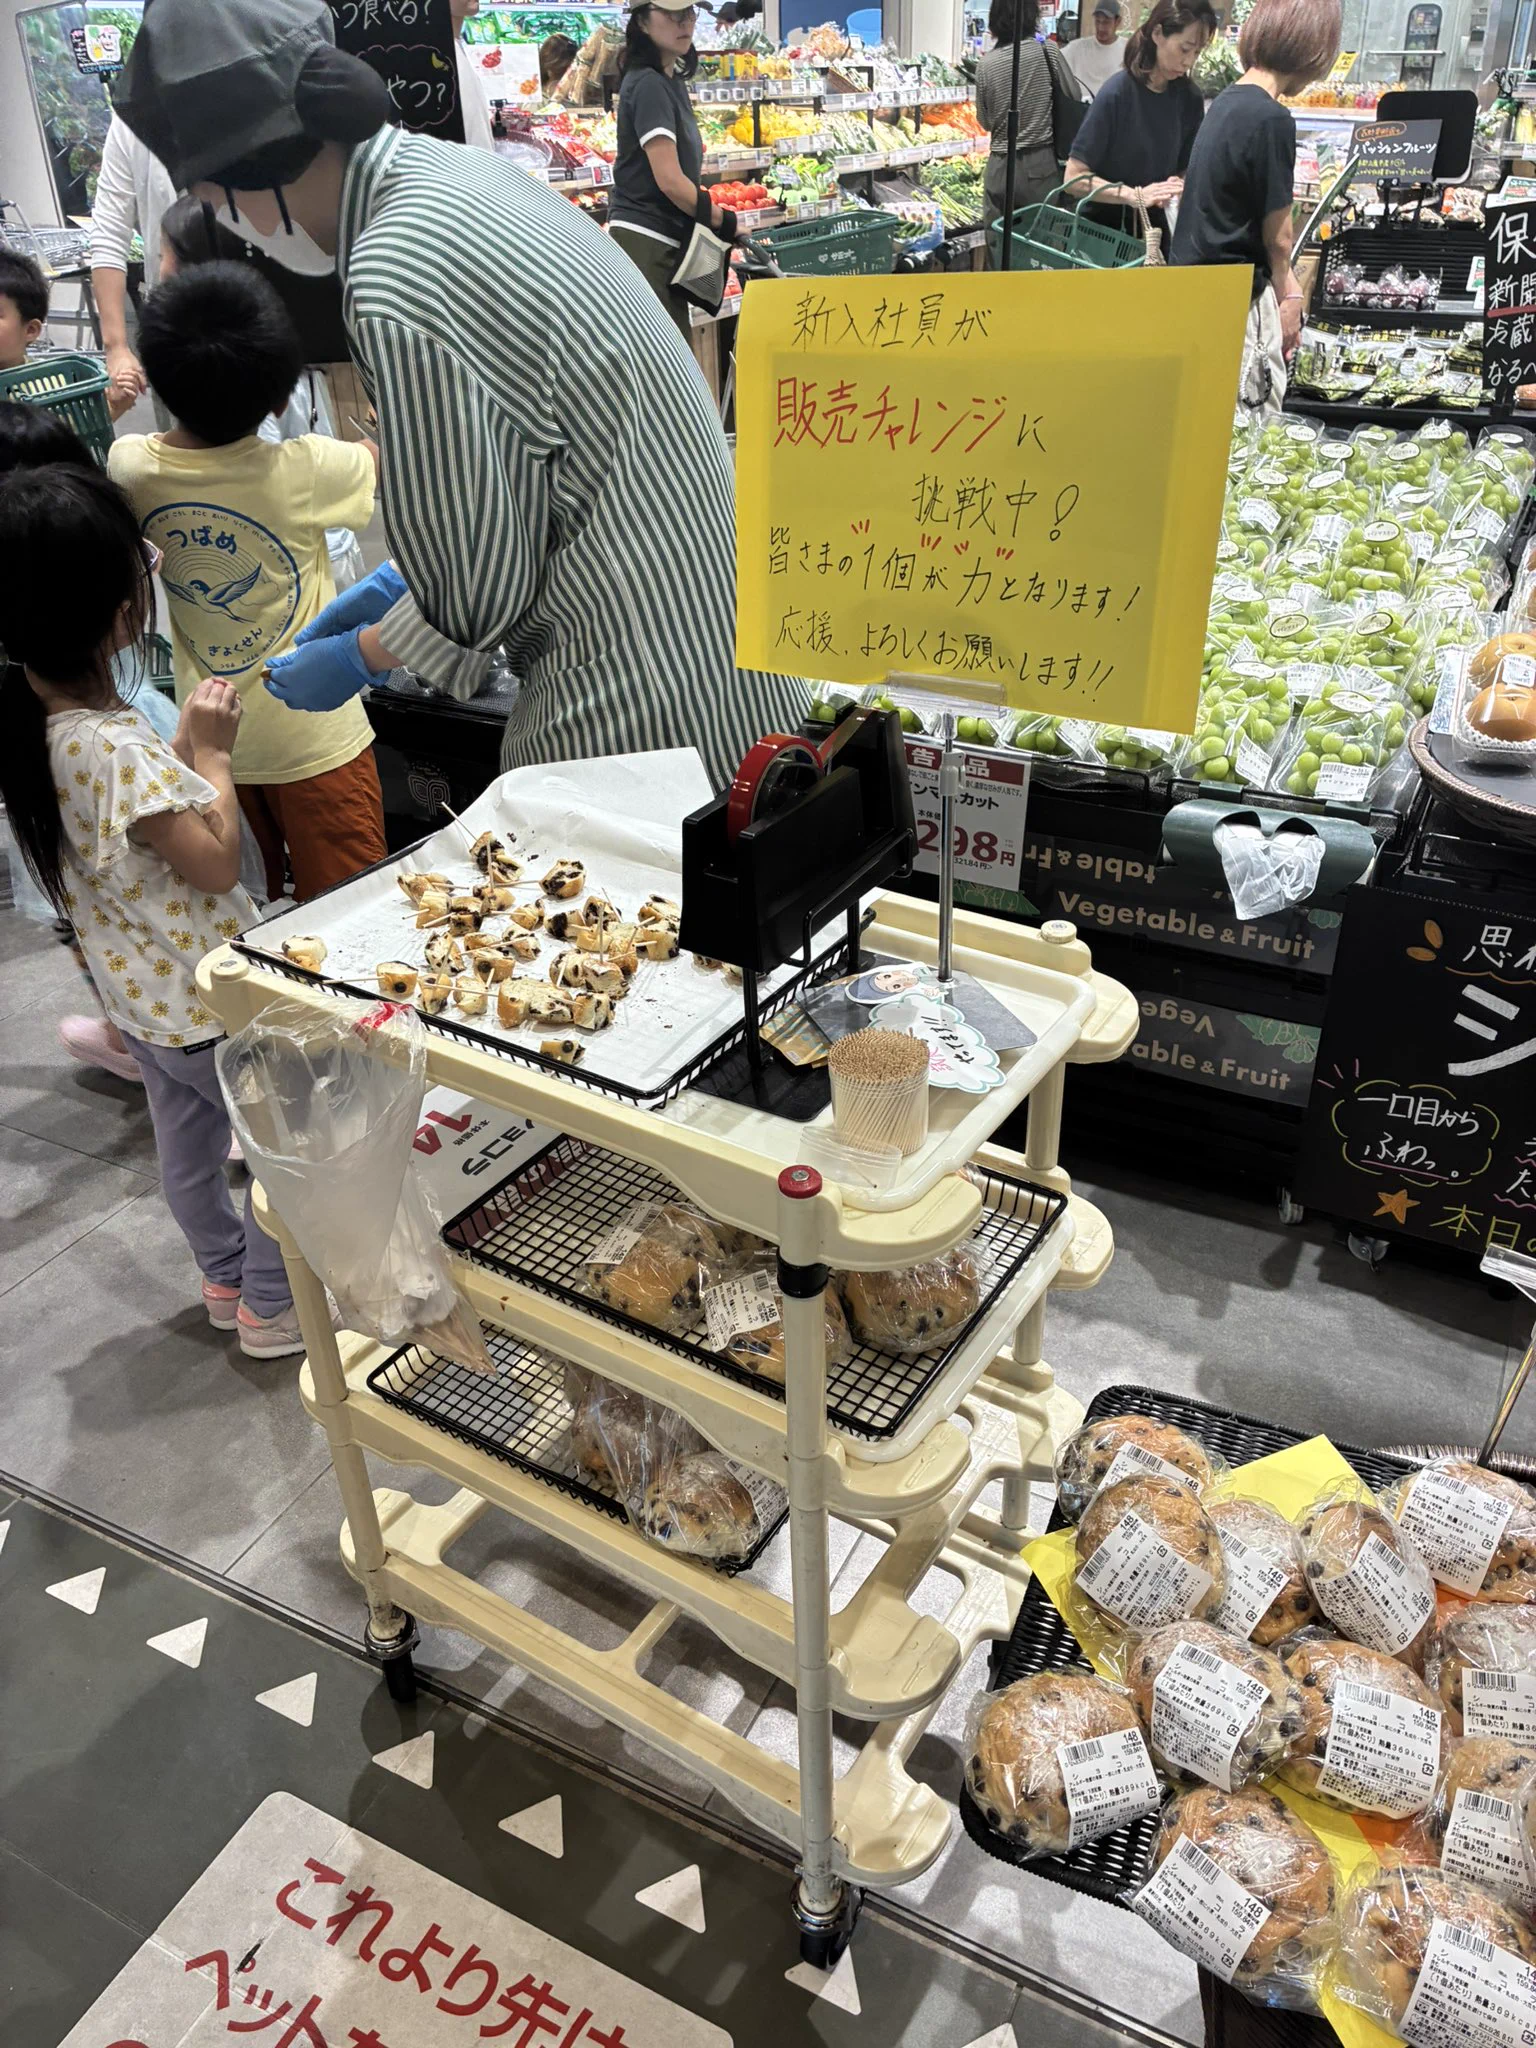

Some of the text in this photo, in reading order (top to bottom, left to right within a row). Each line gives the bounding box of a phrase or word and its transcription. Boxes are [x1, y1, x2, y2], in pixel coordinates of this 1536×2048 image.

[1353, 141, 1437, 155] パッションフルーツ
[792, 290, 992, 352] 新入社員が
[773, 376, 1047, 454] 販売チャレンジに
[165, 524, 237, 556] つばめ
[1057, 889, 1216, 941] Vegetable
[1240, 924, 1316, 960] Fruit
[1358, 1092, 1481, 1137] 一口目から
[766, 1303, 778, 1319] 148
[1183, 1476, 1200, 1492] 148
[1120, 1514, 1134, 1531] 148
[1266, 1566, 1284, 1583] 148
[1245, 1678, 1265, 1696] 148
[1418, 1707, 1436, 1722] 148
[1122, 1730, 1138, 1743] 148
[1242, 1895, 1263, 1919] 148
